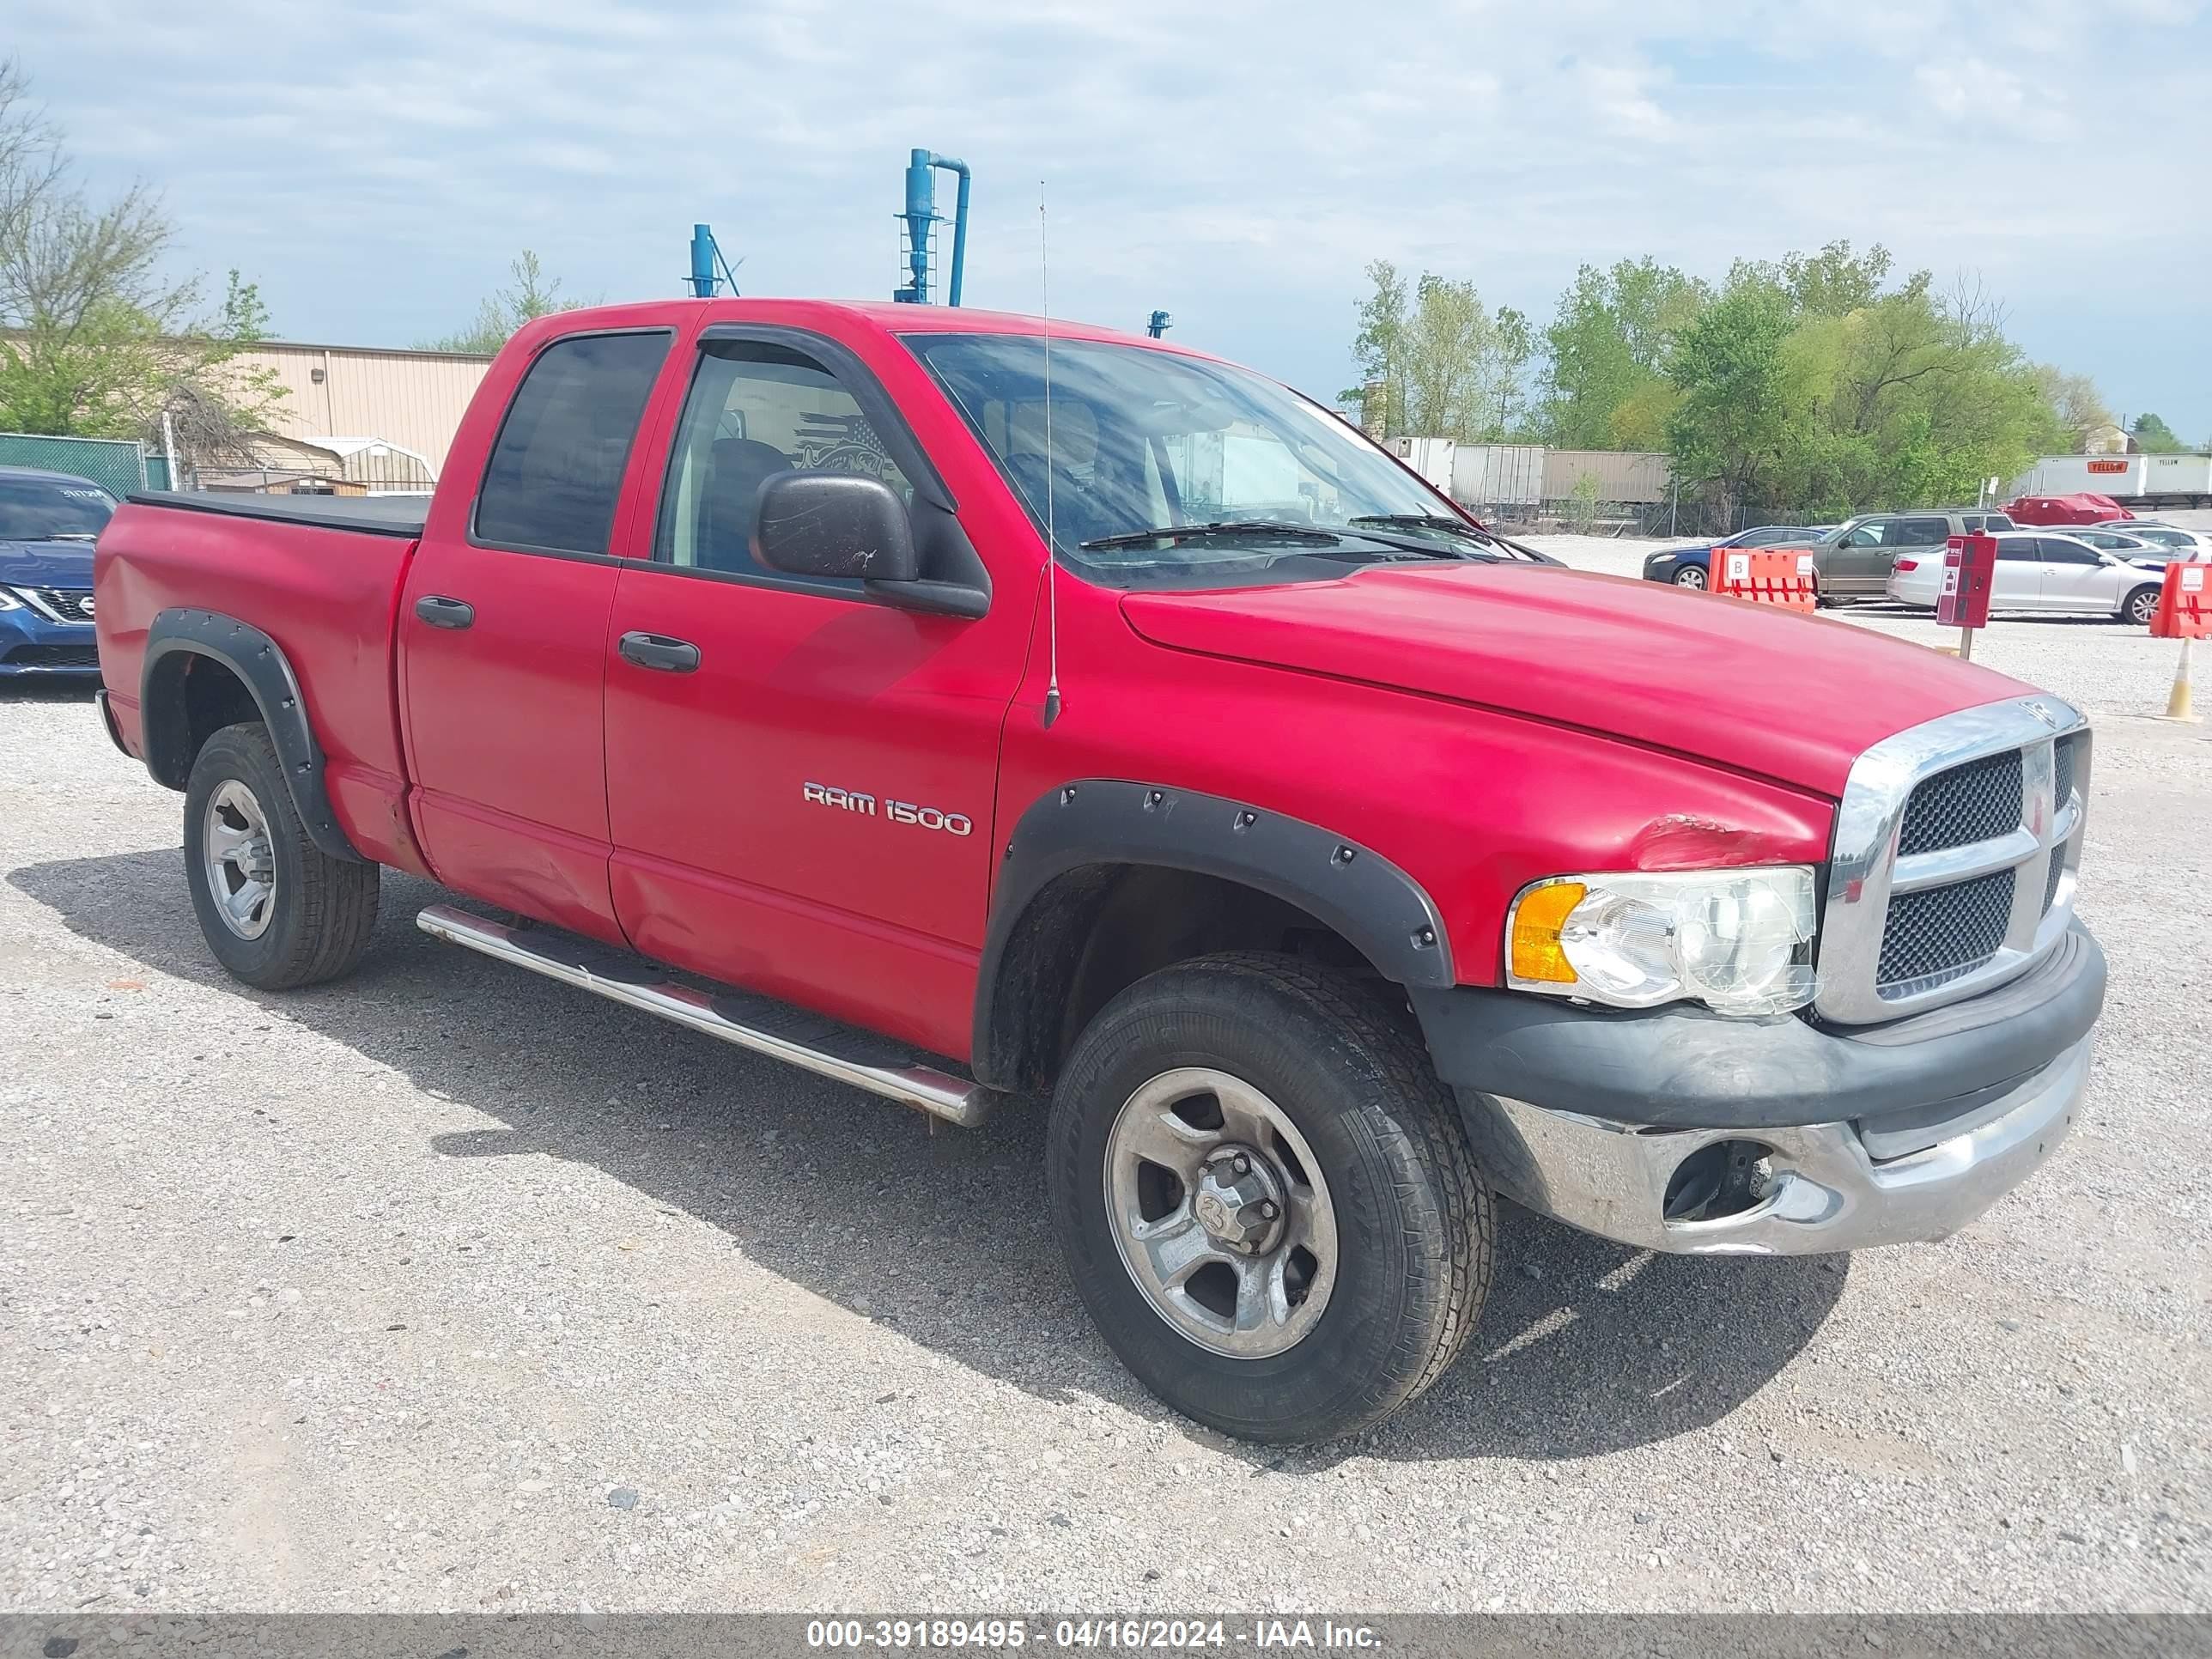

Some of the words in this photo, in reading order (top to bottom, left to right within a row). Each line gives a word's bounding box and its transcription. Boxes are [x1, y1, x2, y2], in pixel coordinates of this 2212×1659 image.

[2092, 463, 2124, 471] YELLOW
[1734, 561, 1743, 574] B
[803, 781, 877, 817] RAM
[884, 799, 973, 836] 1500
